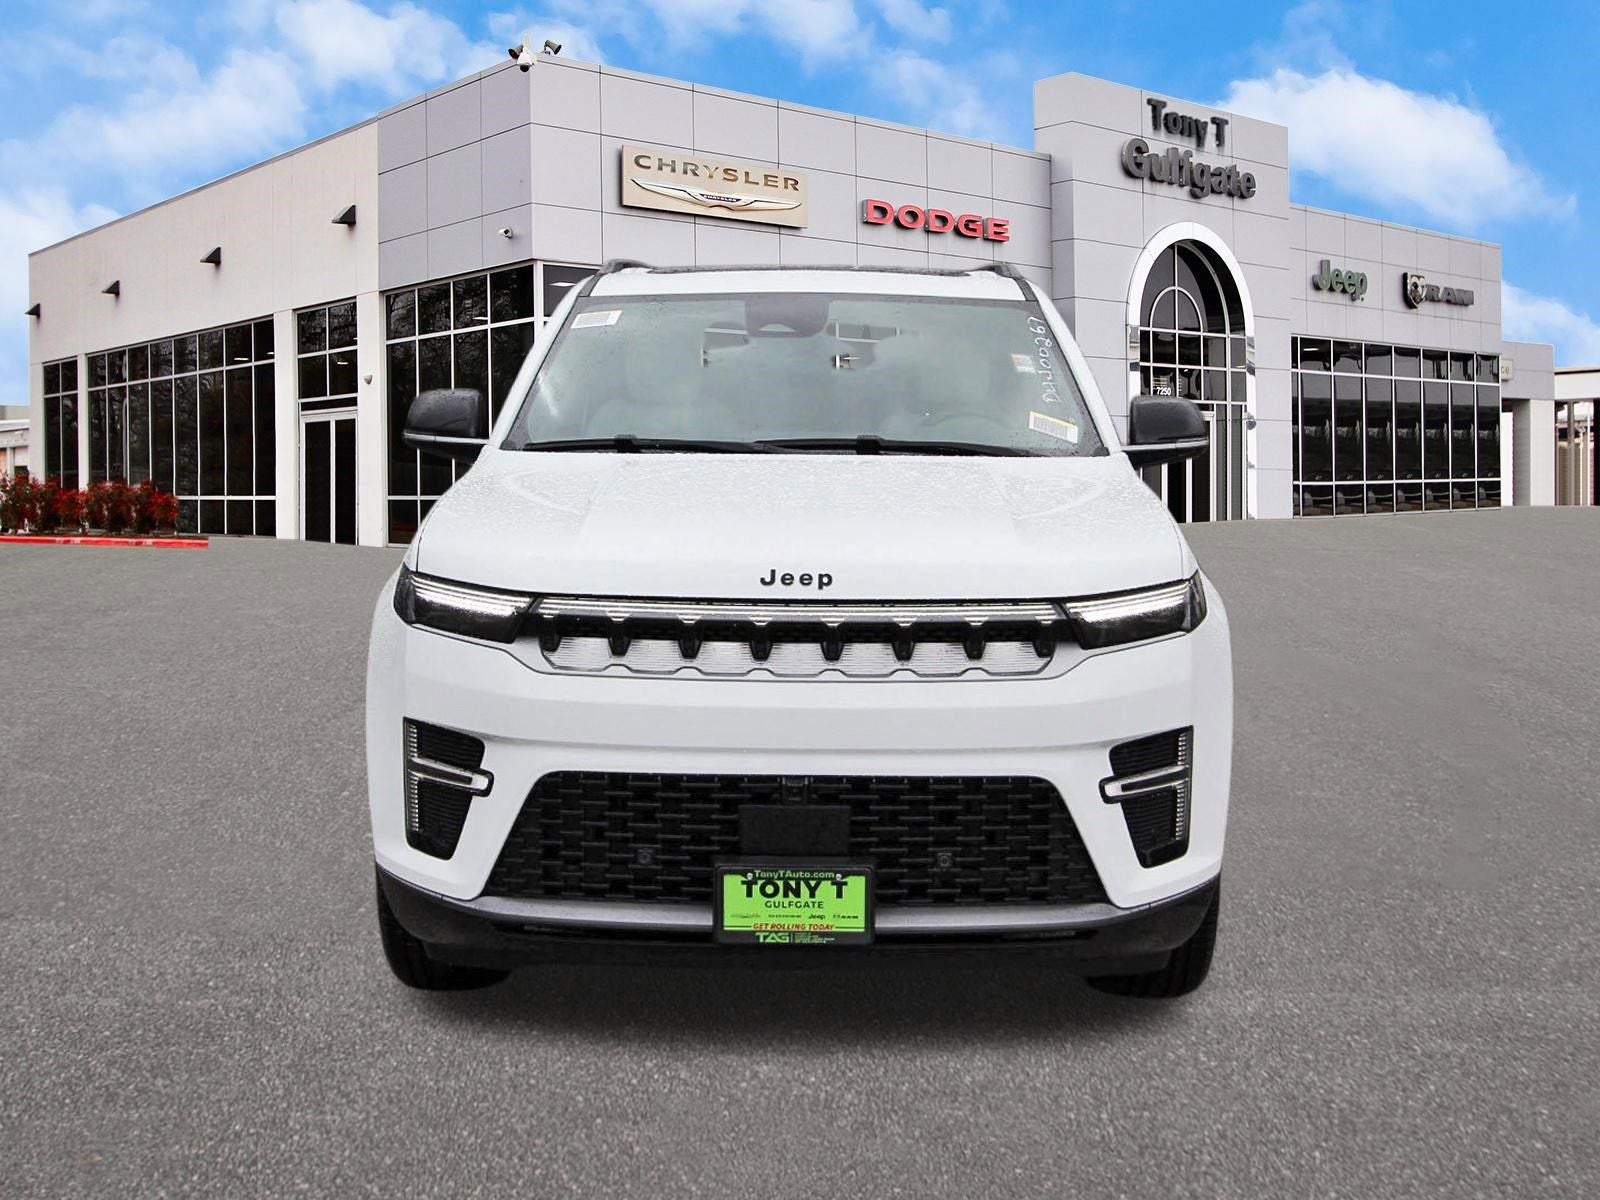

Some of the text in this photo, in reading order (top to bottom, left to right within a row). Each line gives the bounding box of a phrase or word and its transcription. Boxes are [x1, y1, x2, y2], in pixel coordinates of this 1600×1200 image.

[1147, 98, 1229, 147] Tony T
[634, 154, 800, 192] CHRYSLER
[1121, 138, 1256, 198] Gulfgate
[862, 198, 1010, 242] DODGE
[1312, 259, 1368, 302] Jeep
[1425, 284, 1474, 306] RAM
[1156, 387, 1172, 396] 7250
[759, 568, 833, 590] Jeep
[755, 870, 835, 880] TonyTAuto.com
[741, 880, 848, 899] TONY T
[765, 900, 824, 909] GULFGATE
[755, 932, 789, 943] TAG
